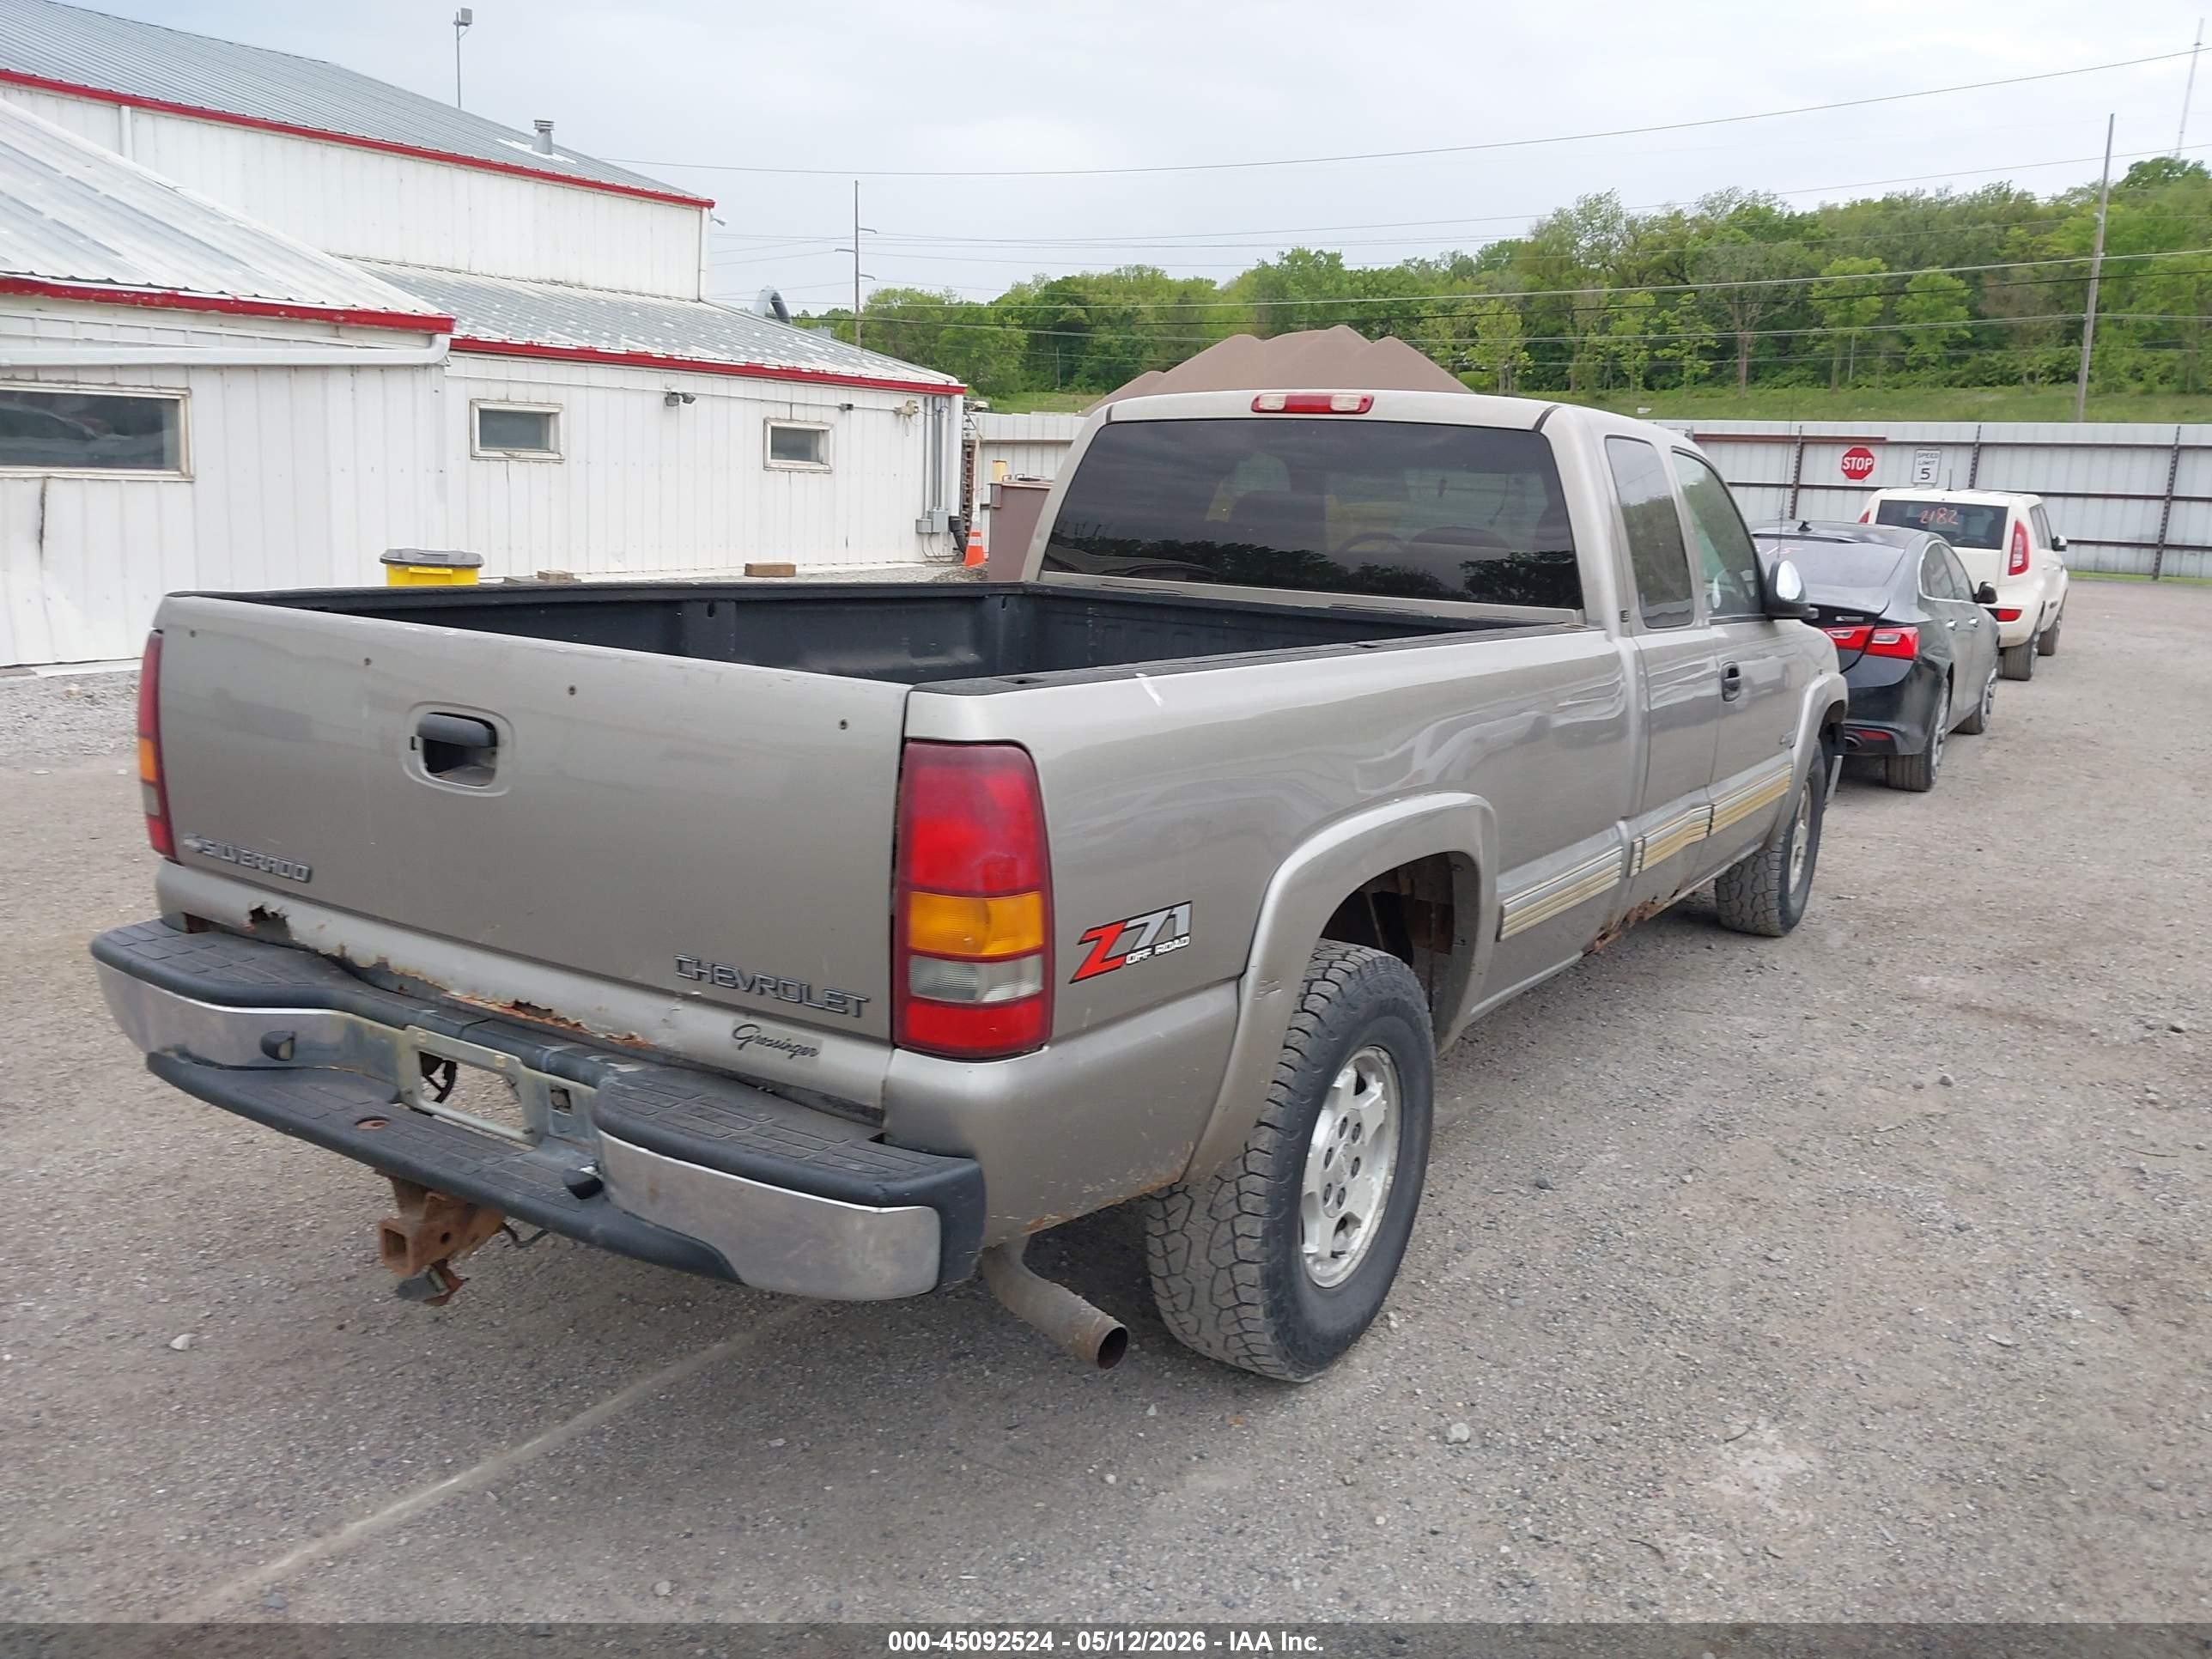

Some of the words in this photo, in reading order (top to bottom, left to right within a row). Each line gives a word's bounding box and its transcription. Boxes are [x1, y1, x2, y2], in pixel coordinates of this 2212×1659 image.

[1842, 457, 1874, 471] STOP
[1920, 467, 1931, 480] 5
[199, 837, 312, 883] SILVERADO
[1067, 900, 1193, 984] Z71
[1126, 948, 1152, 965] OFF
[1155, 936, 1191, 956] ROAD
[673, 953, 871, 1018] CHEVROLET
